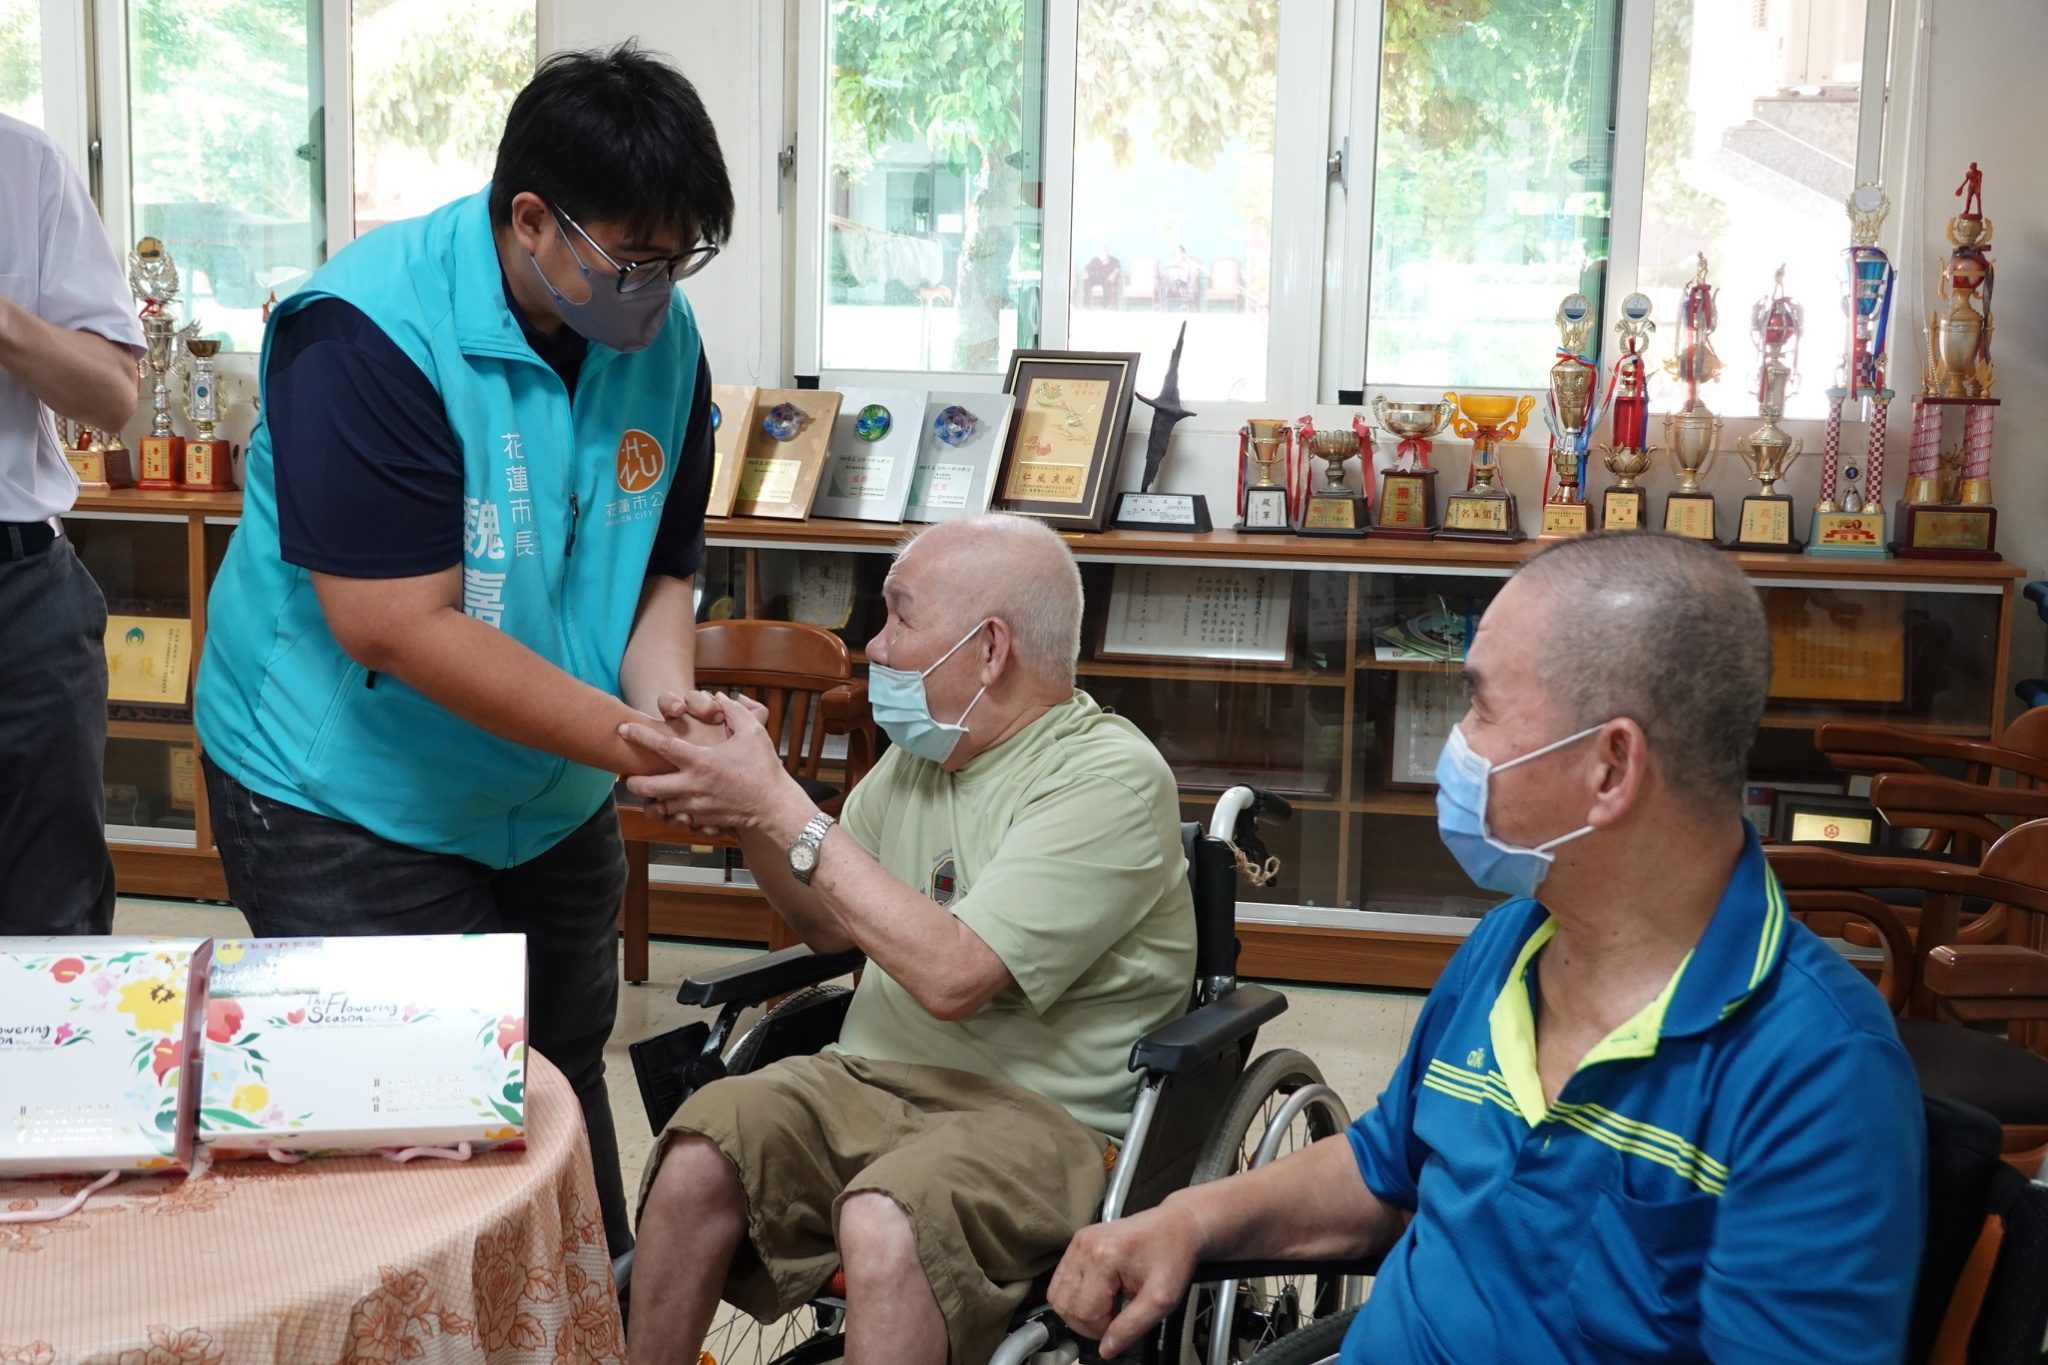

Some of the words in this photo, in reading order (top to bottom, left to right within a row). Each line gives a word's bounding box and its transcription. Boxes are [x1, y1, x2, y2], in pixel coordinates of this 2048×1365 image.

[501, 431, 536, 559] 花蓮市長
[1395, 487, 1409, 522] 第一名
[307, 1006, 364, 1024] Season
[325, 990, 398, 1017] Flowering
